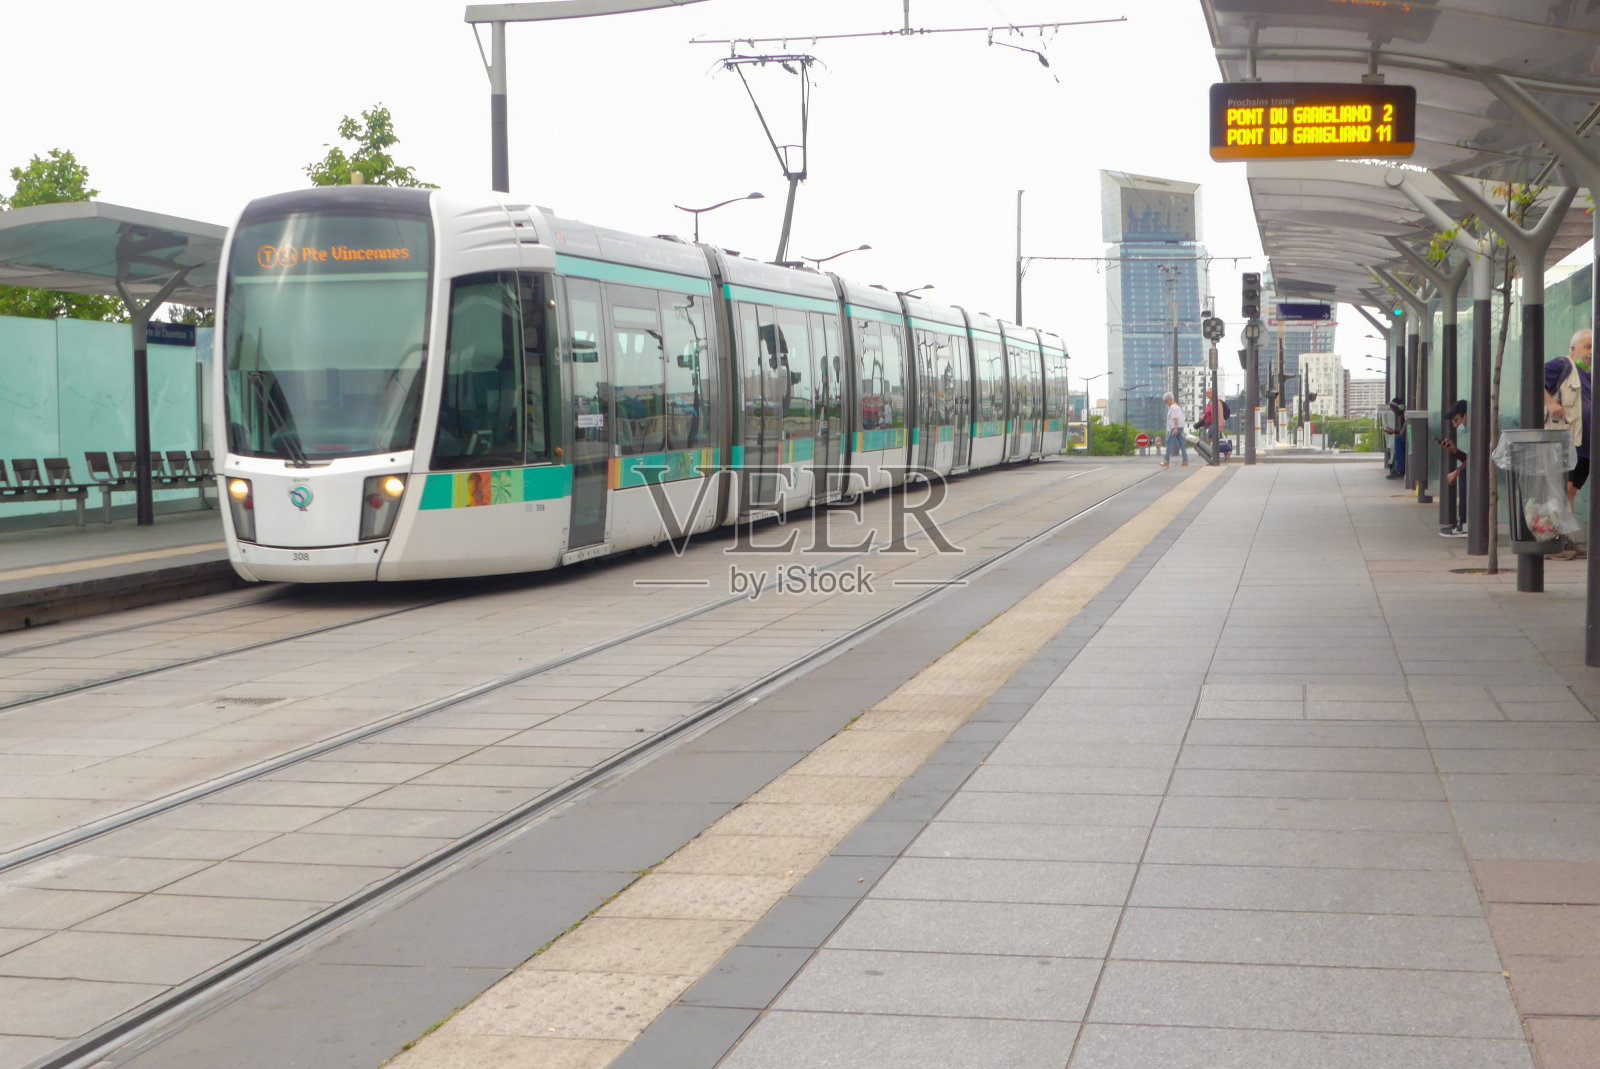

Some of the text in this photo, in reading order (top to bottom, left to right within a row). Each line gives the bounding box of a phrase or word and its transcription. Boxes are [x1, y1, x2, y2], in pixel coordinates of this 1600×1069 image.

[1228, 98, 1295, 107] Prochains trams
[1227, 104, 1393, 126] PONT DU GARIGLIANO 2
[1227, 124, 1392, 146] PONT DU GARIGLIANO 11
[302, 247, 328, 262] Pte
[331, 246, 410, 261] Vincennes
[293, 552, 309, 561] 308
